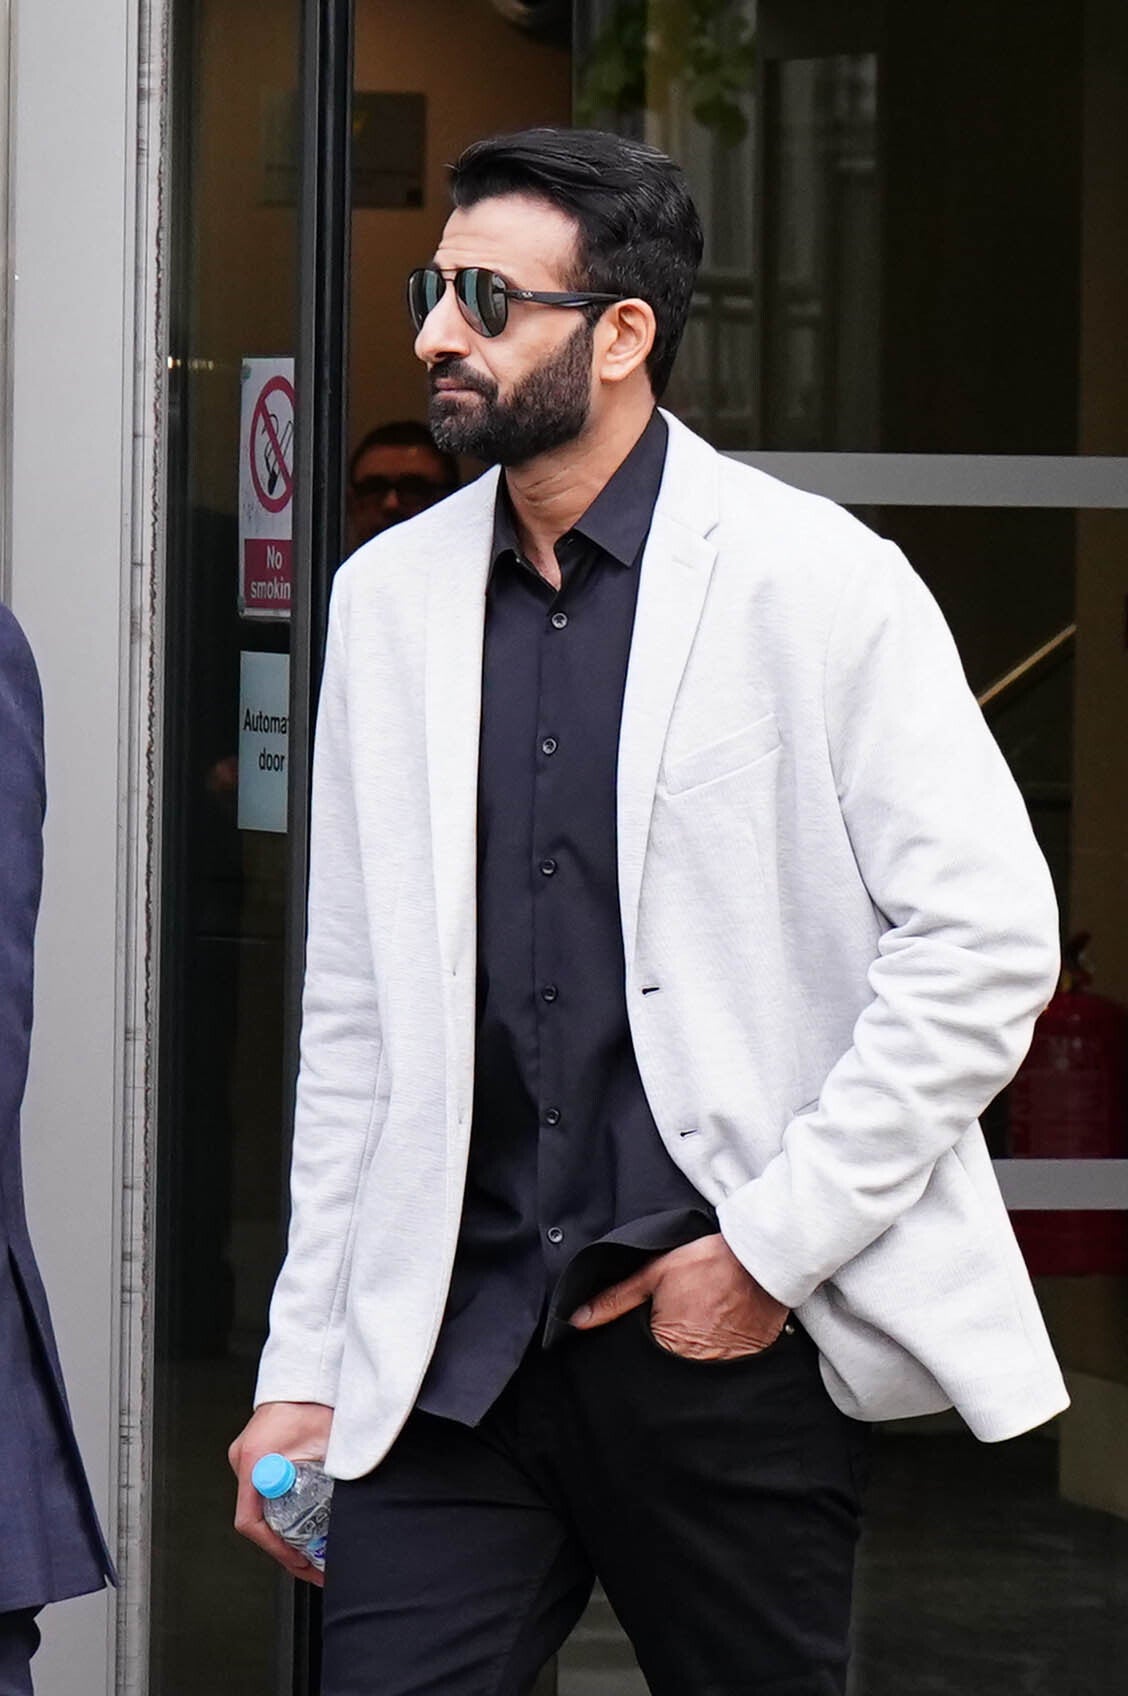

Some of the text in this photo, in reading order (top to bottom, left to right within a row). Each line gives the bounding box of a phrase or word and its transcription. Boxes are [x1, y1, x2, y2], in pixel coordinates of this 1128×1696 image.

[266, 545, 283, 570] No
[250, 576, 291, 600] smokin
[243, 708, 290, 734] Automa
[259, 747, 285, 771] door
